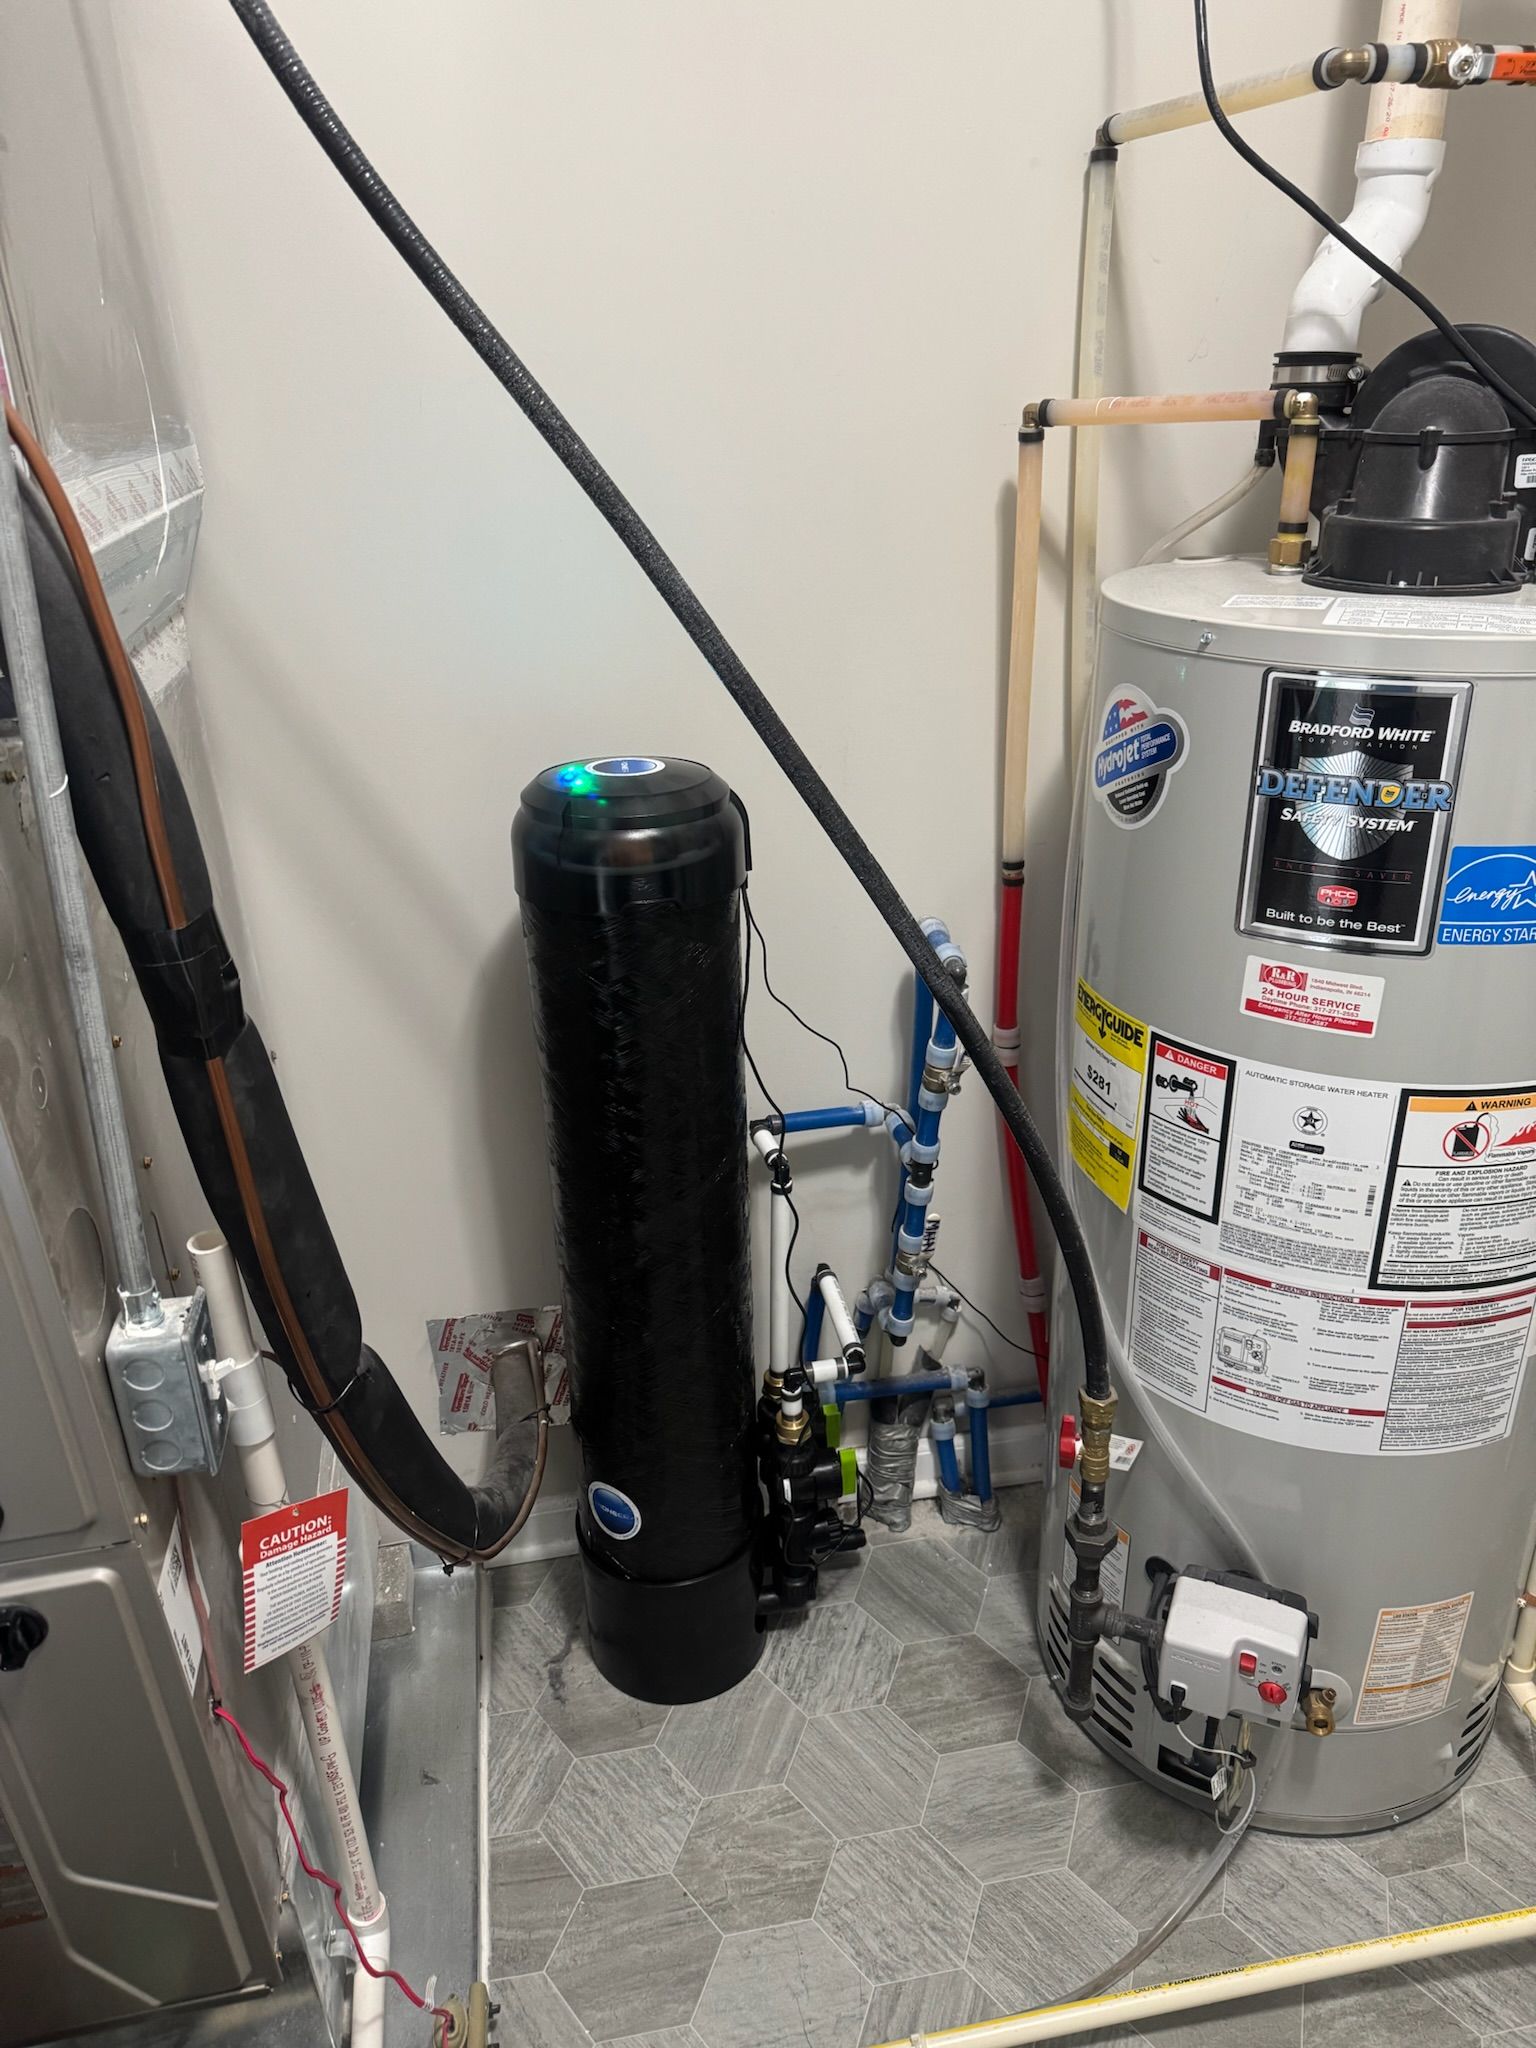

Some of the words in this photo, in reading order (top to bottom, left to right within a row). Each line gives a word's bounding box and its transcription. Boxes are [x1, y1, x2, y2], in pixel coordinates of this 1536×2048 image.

[1288, 719, 1375, 740] BRADFORD
[1377, 726, 1432, 743] WHITE
[1297, 736, 1419, 750] CORPORATION
[1097, 740, 1140, 782] Hydrojet
[1257, 767, 1454, 811] DEFENDER
[1346, 815, 1415, 833] SYSTEM
[1320, 888, 1356, 899] PHCC
[1447, 886, 1520, 911] energy
[1265, 908, 1295, 922] Built
[1299, 913, 1313, 924] to
[1317, 916, 1335, 927] be
[1339, 919, 1363, 930] the
[1367, 922, 1401, 934] Best
[1442, 928, 1502, 942] ENERGY
[1503, 928, 1536, 942] STAR
[1271, 968, 1296, 982] R&R
[1261, 987, 1274, 996] 24
[1277, 990, 1310, 1003] HOUR
[1312, 997, 1361, 1012] SERVICE
[1261, 995, 1288, 1007] Daytime
[1289, 1001, 1313, 1010] Phone:
[1257, 1002, 1294, 1014] Emergency
[1312, 1013, 1333, 1023] Hours
[1333, 1017, 1359, 1026] Phone:
[1177, 1052, 1217, 1076] DANGER
[1086, 1064, 1111, 1096] $281
[1244, 1070, 1288, 1085] AUTOMATIC
[1288, 1079, 1326, 1092] STORAGE
[1327, 1086, 1356, 1096] WATER
[1356, 1090, 1389, 1099] HEATER
[1184, 1099, 1200, 1109] HOT
[1481, 1098, 1532, 1110] WARNING
[1487, 1151, 1516, 1159] Flammable
[454, 1386, 465, 1412] Venture
[259, 1515, 332, 1551] CAUTION:
[259, 1540, 299, 1560] Damage
[301, 1524, 332, 1544] Hazard
[265, 1554, 293, 1568] Attention
[293, 1540, 327, 1560] Homeowner:
